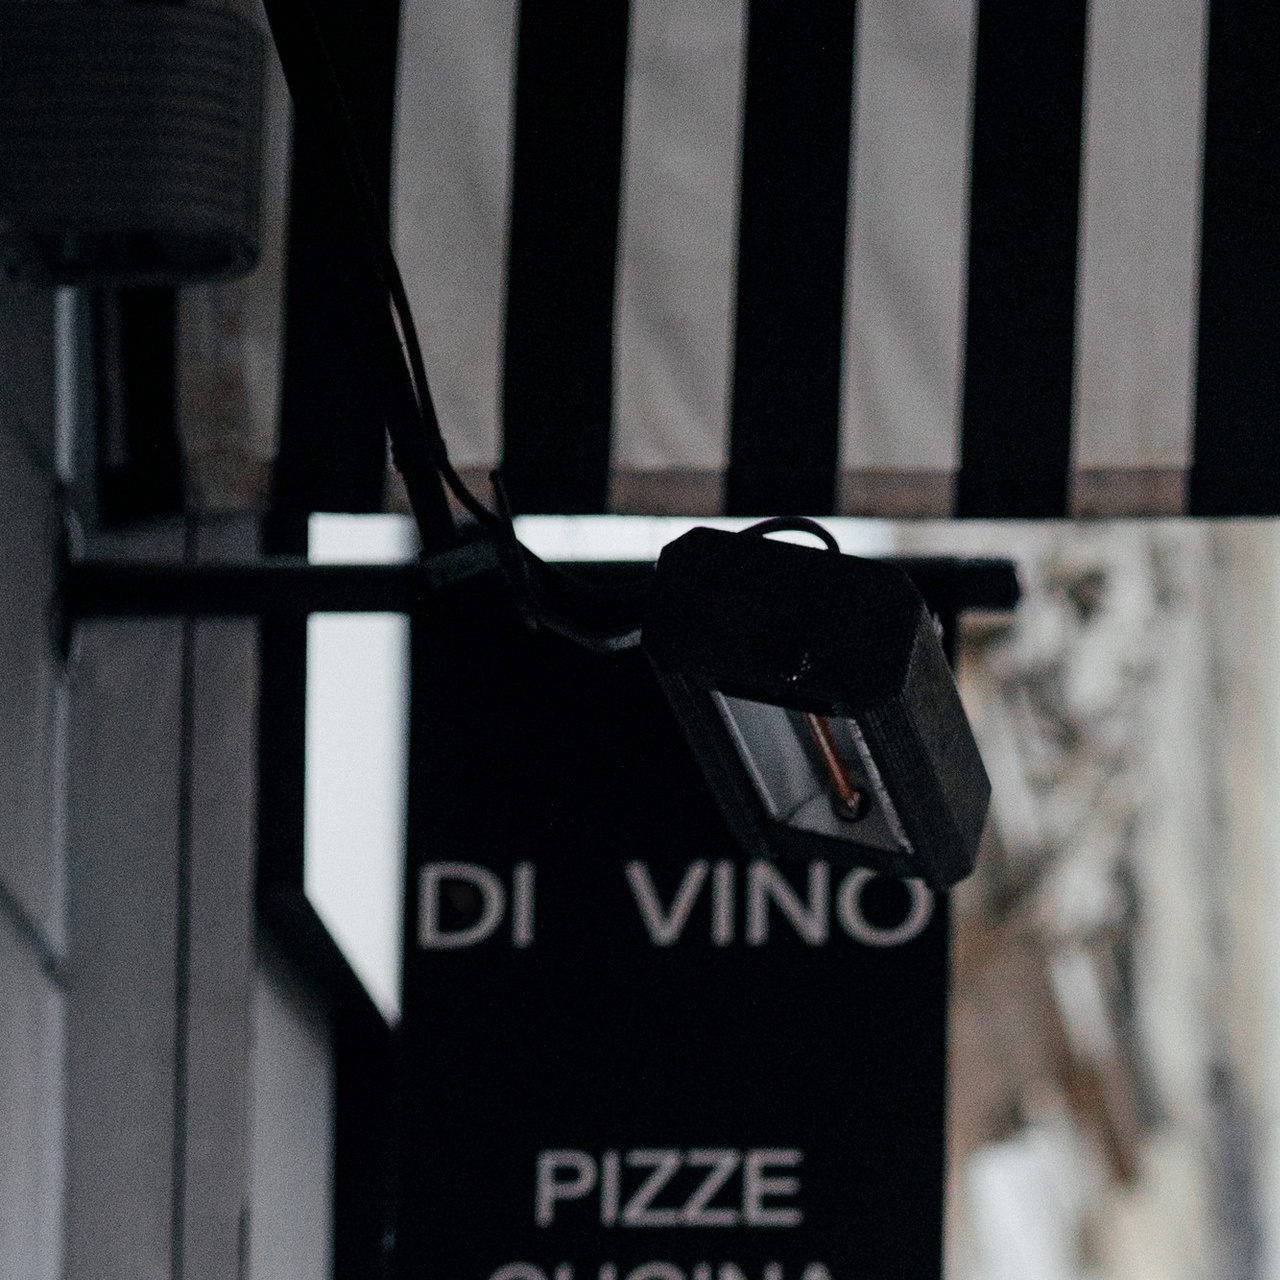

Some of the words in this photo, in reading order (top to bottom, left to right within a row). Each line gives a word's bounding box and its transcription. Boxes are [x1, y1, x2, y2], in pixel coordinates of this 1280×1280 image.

[417, 862, 535, 949] DI
[626, 859, 934, 946] VINO
[535, 1148, 803, 1228] PIZZE
